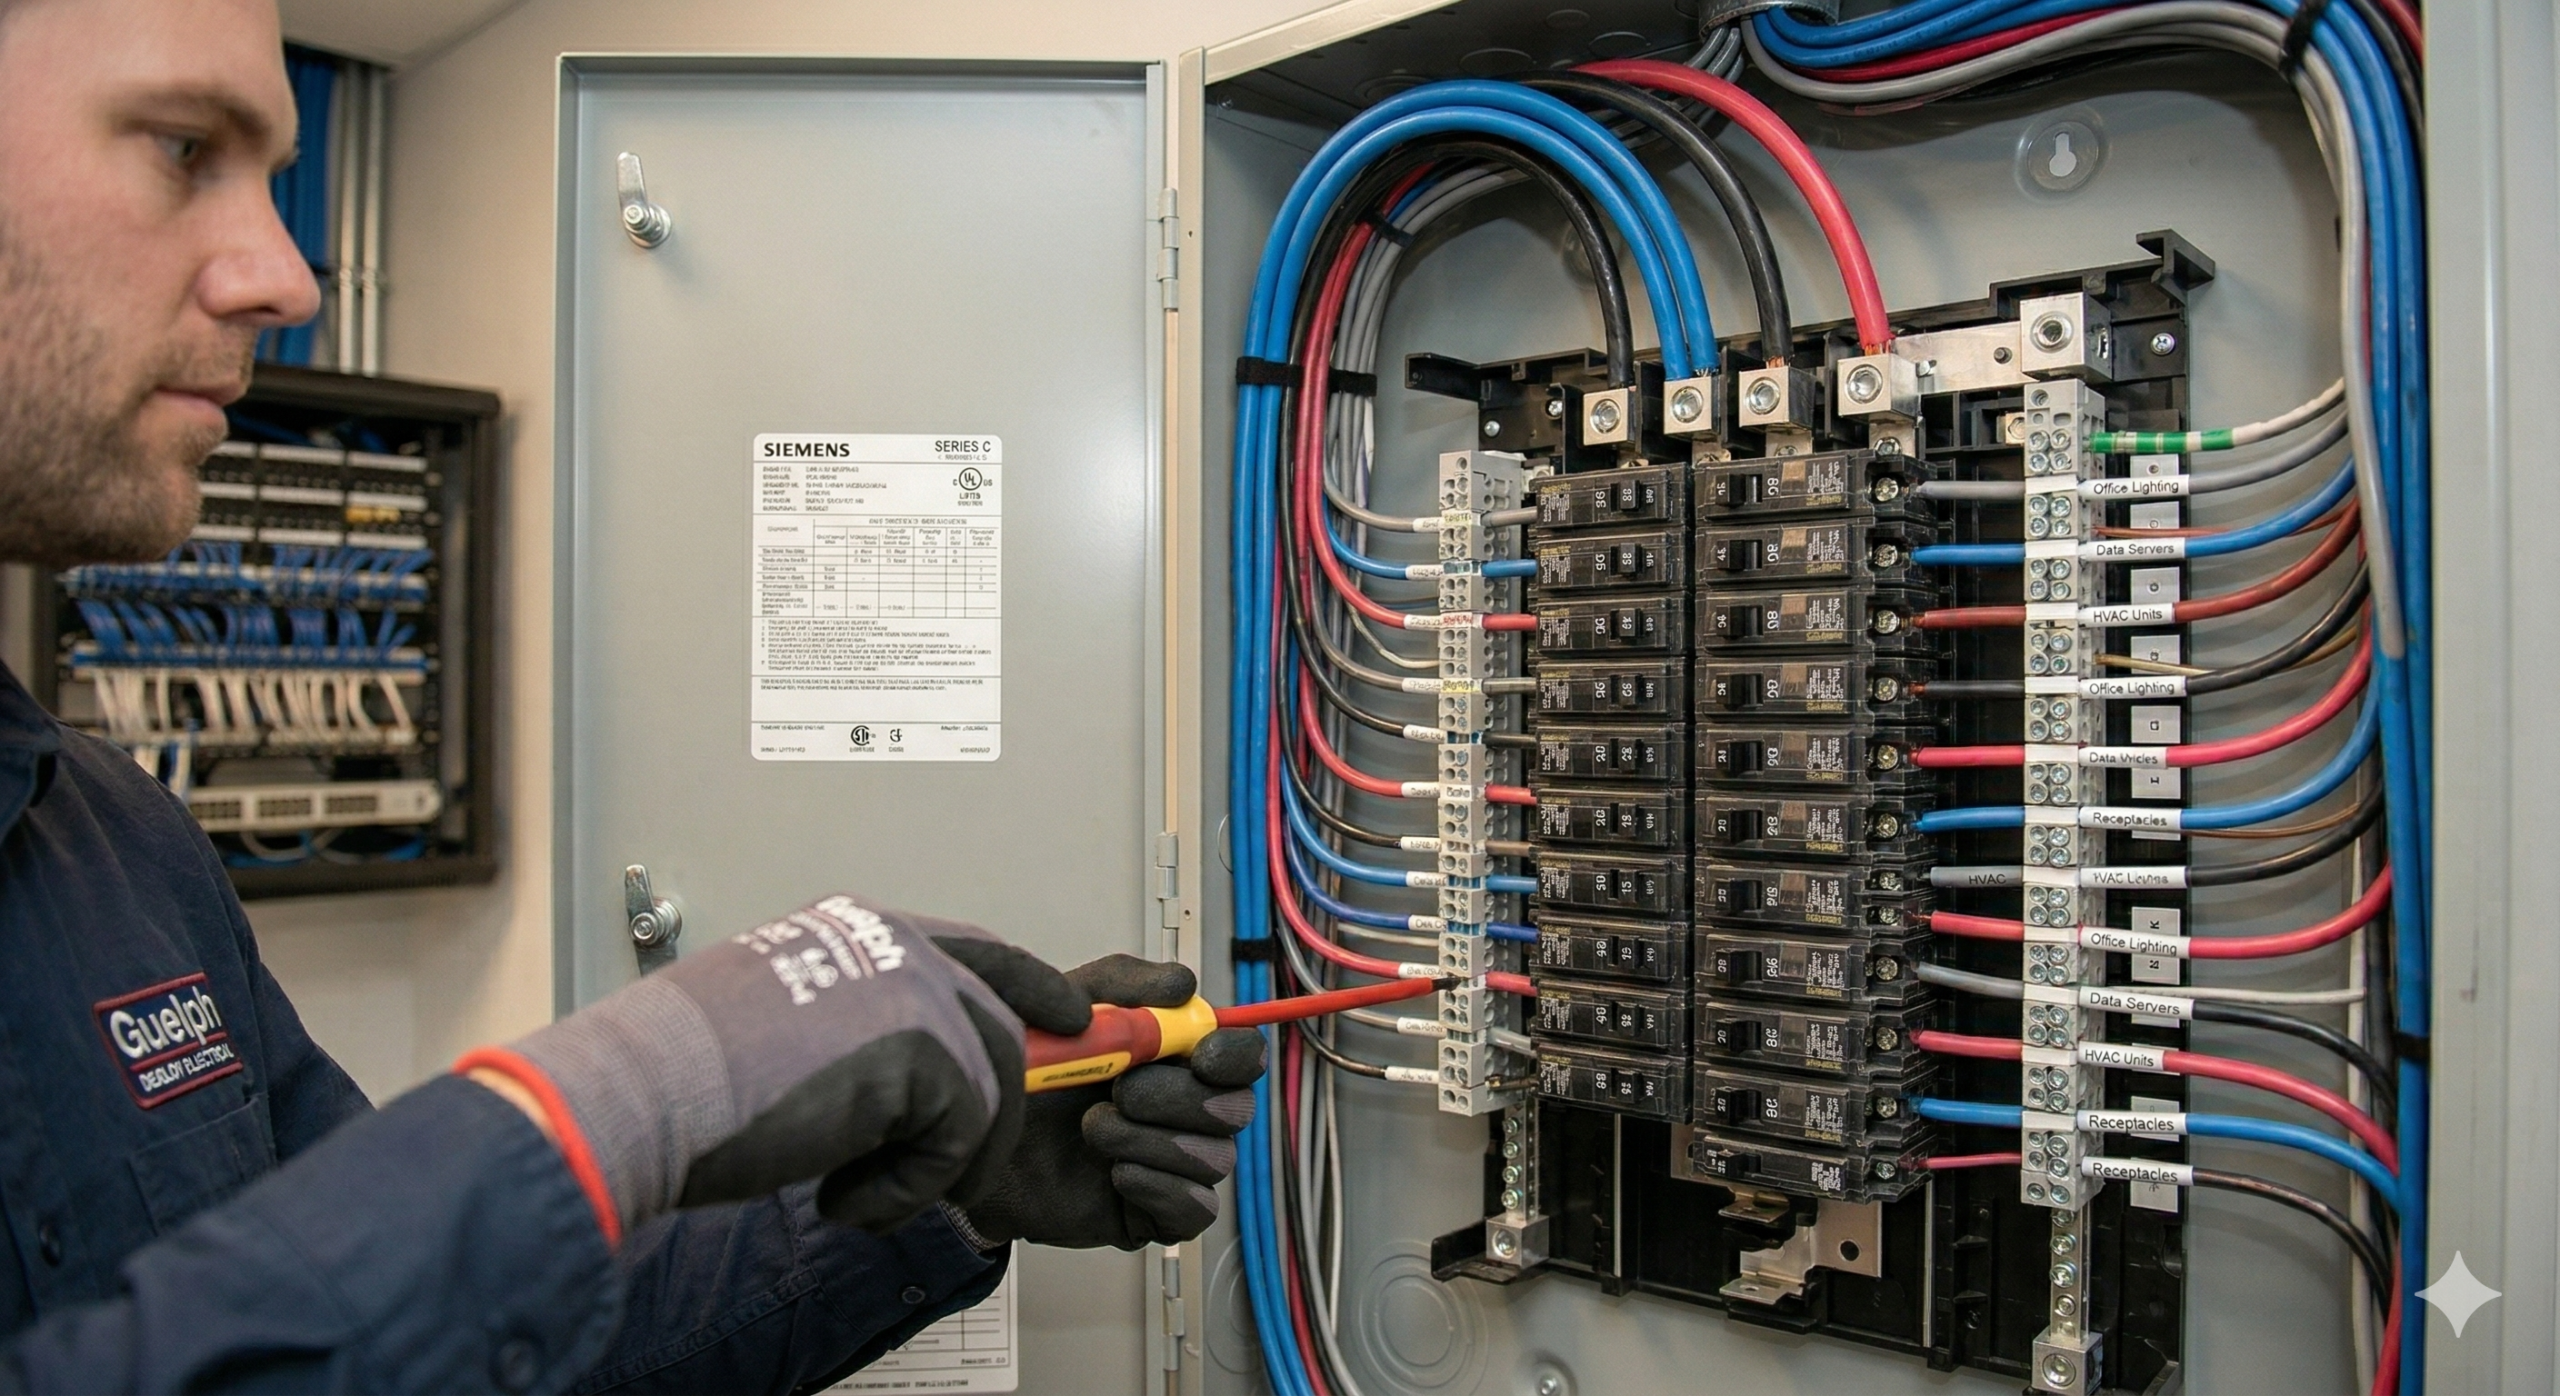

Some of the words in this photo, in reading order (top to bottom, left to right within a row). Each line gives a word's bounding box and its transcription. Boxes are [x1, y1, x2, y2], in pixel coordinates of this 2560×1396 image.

[763, 443, 850, 457] SIEMENS
[934, 440, 979, 452] SERIES
[982, 441, 991, 452] C
[2093, 482, 2129, 495] Office
[2132, 479, 2179, 494] Lighting
[2096, 544, 2125, 556] Data
[2128, 543, 2175, 555] Servers
[2093, 610, 2129, 622] HVAC
[2132, 609, 2163, 620] Units
[2127, 681, 2175, 696] Lighting
[2089, 751, 2117, 763] Data
[1968, 873, 2007, 885] HVAC
[2091, 932, 2126, 948] Office
[2130, 938, 2177, 956] Lighting
[2090, 992, 2122, 1008] Data
[2126, 997, 2180, 1015] Servers
[110, 985, 222, 1058] Guelph
[2085, 1049, 2120, 1063] HVAC
[2124, 1053, 2154, 1067] Units
[2089, 1115, 2175, 1131] Receptacles
[2093, 1163, 2178, 1183] Receptacles
